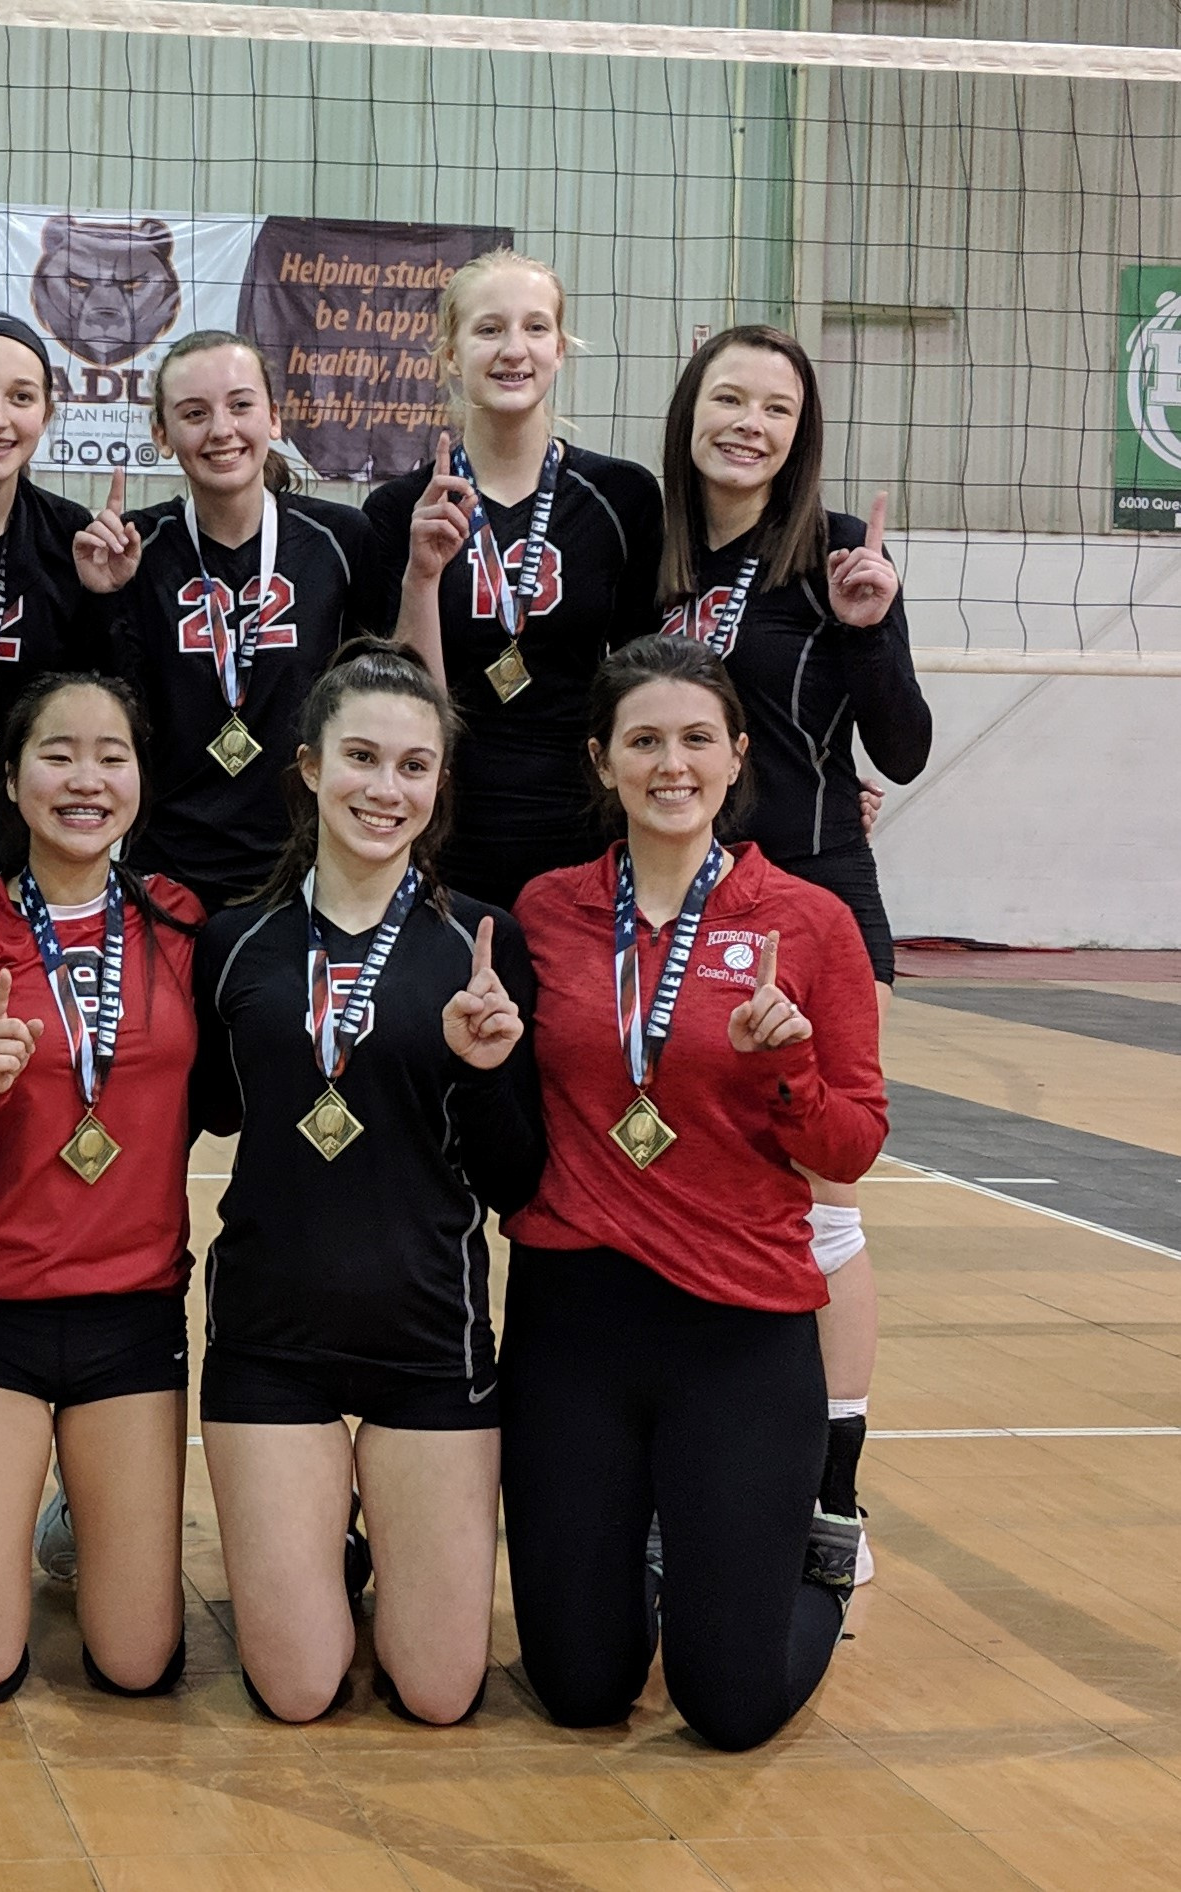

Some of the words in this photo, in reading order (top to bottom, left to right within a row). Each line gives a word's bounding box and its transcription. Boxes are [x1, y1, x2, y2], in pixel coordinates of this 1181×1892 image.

[280, 252, 381, 294] Helping
[315, 299, 350, 331] be
[288, 345, 392, 386] healthy,
[102, 409, 143, 424] HIGH
[281, 388, 366, 431] highly
[1118, 496, 1150, 510] 6000
[1151, 497, 1181, 511] Que
[517, 491, 555, 595] VOLLEYBALL
[467, 538, 563, 619] 13
[177, 572, 298, 653] 22
[706, 930, 754, 947] KIDRON
[339, 922, 401, 1034] VOLLEYBALL
[646, 912, 702, 1037] VOLLEYBALL
[696, 964, 730, 982] Coach
[96, 933, 124, 1056] VOLLEYBALL
